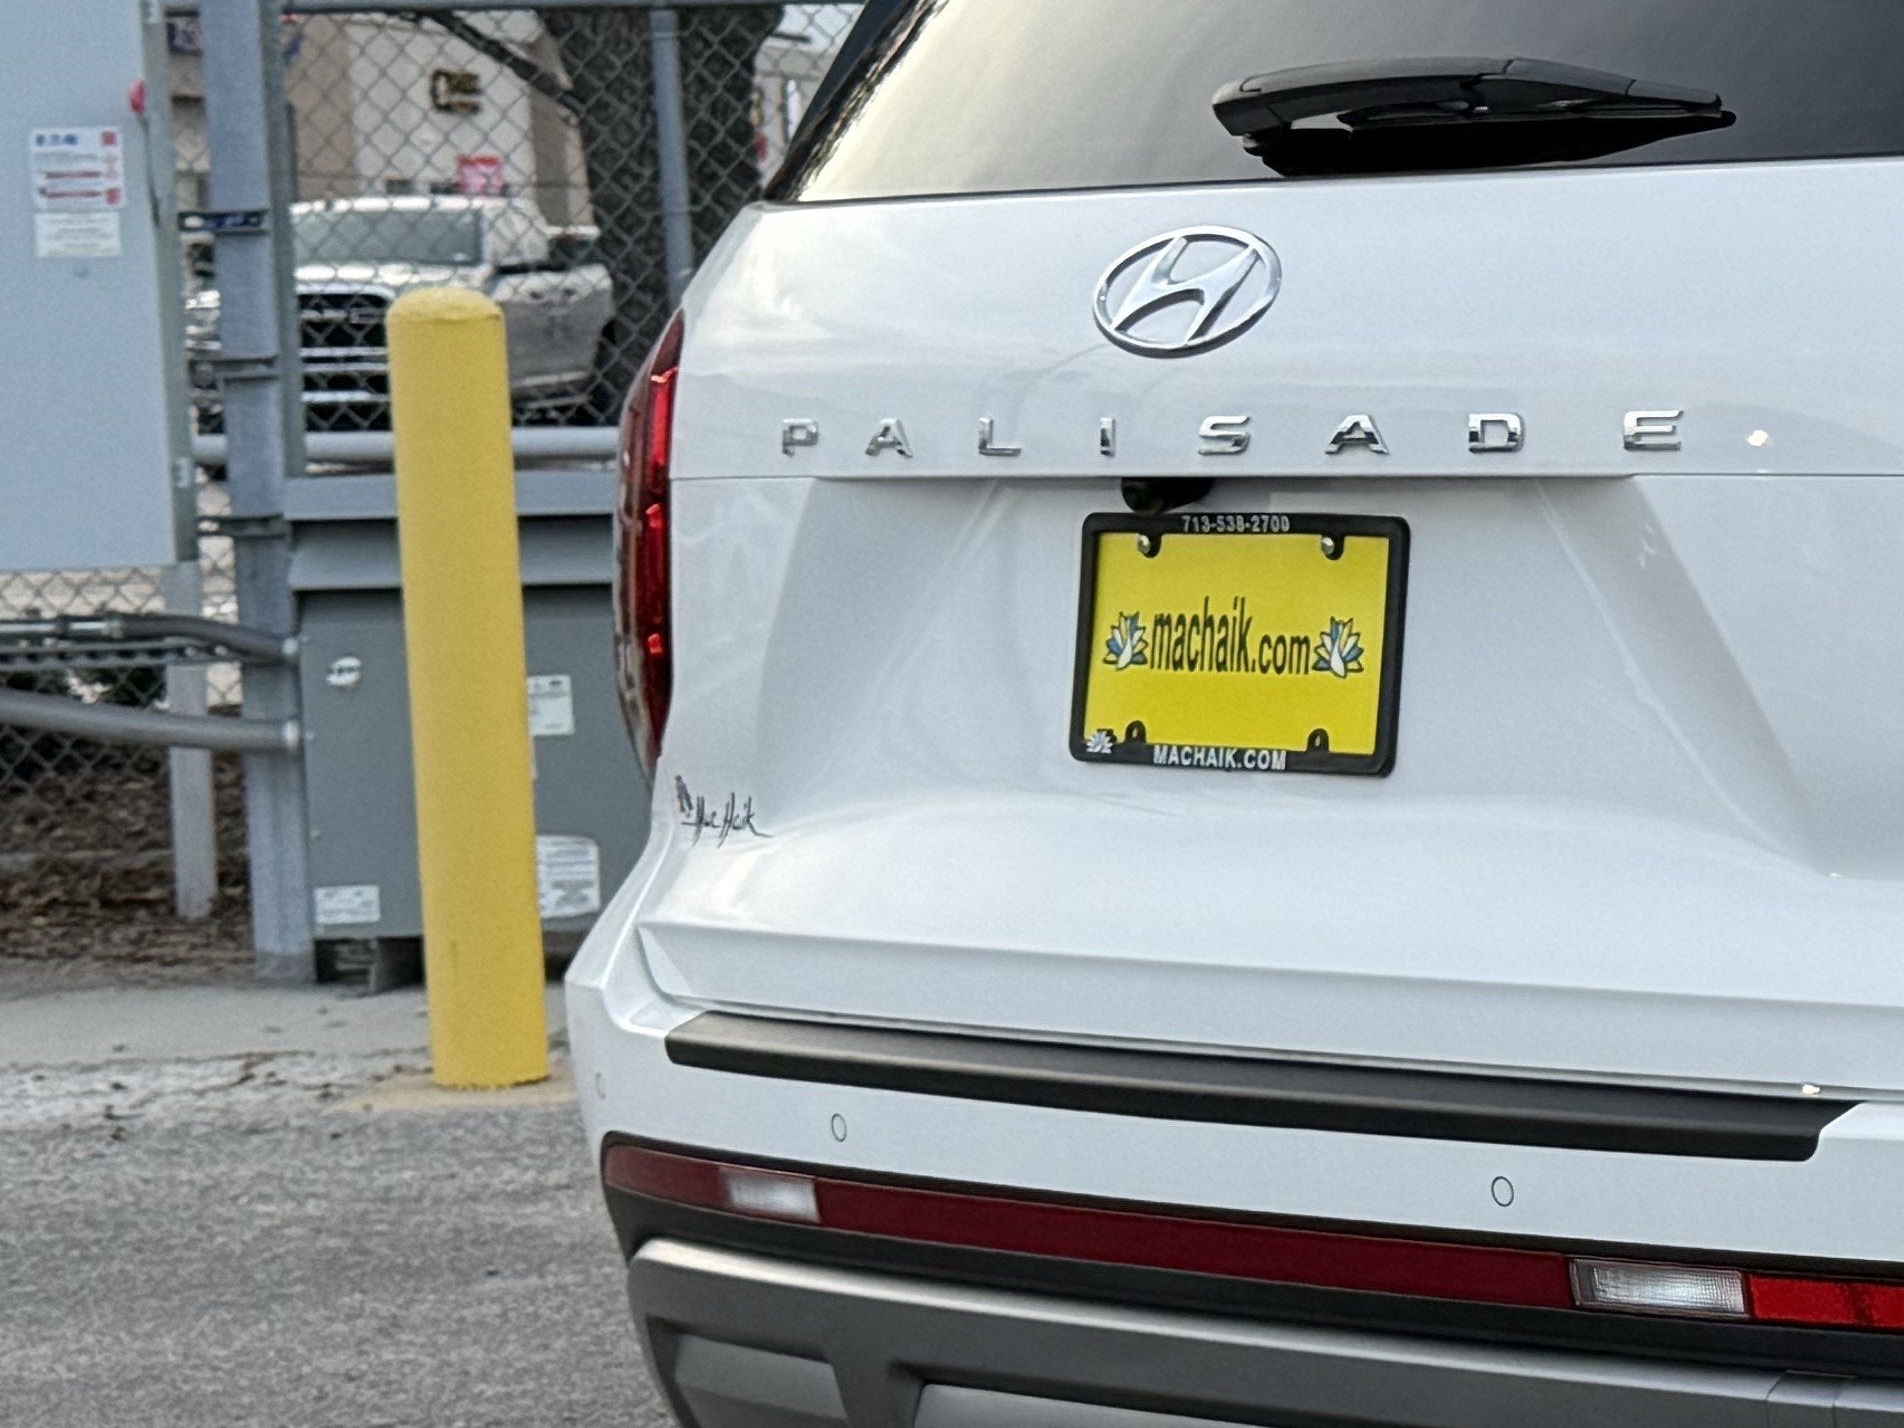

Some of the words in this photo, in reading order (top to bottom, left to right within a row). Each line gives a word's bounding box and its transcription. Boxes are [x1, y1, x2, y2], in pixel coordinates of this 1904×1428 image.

[781, 409, 1685, 459] PALISADE
[1181, 514, 1291, 534] 713-538-2700
[1150, 594, 1311, 676] machaik.com
[1152, 744, 1287, 771] MACHAIK.COM
